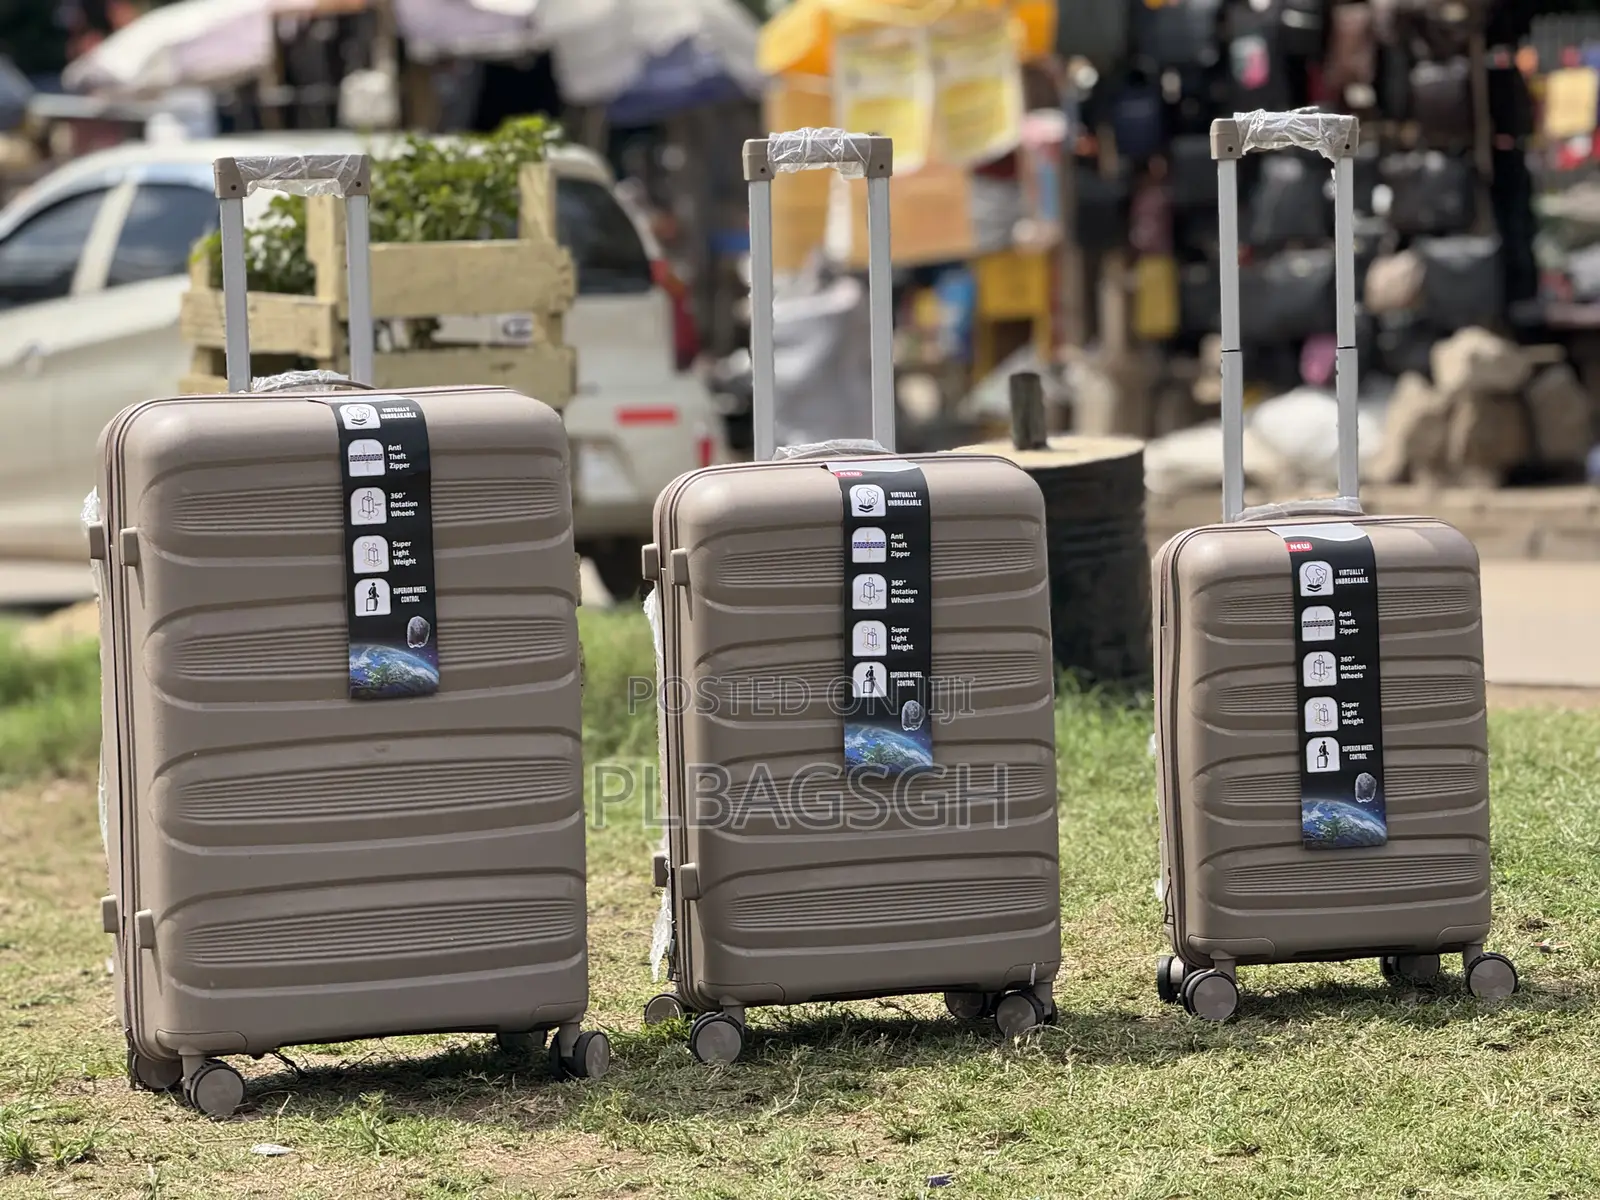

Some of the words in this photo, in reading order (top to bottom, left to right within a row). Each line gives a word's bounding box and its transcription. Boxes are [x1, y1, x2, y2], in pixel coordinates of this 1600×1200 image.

[389, 462, 411, 470] Zipper
[887, 499, 922, 507] UNBREAKABLE
[391, 509, 415, 517] Wheels
[392, 540, 412, 549] Super
[393, 549, 410, 557] Light
[890, 550, 911, 558] Zipper
[393, 558, 417, 567] Weight
[1338, 568, 1365, 576] VIRTUALLY
[1335, 576, 1369, 585] UNBREAKABLE
[393, 586, 413, 595] SUPERIOR
[413, 585, 427, 593] WHEEL
[401, 595, 420, 603] CONTROL
[891, 626, 910, 634] Super
[1339, 627, 1359, 635] Zipper
[891, 635, 907, 643] Light
[891, 643, 914, 651] Weight
[1340, 672, 1364, 680] Wheels
[897, 679, 916, 687] CONTROL
[1341, 701, 1360, 709] Super
[1341, 709, 1358, 717] Light
[1342, 745, 1361, 753] SUPERIOR
[1361, 743, 1374, 751] WHEEL
[1349, 753, 1368, 761] CONTROL
